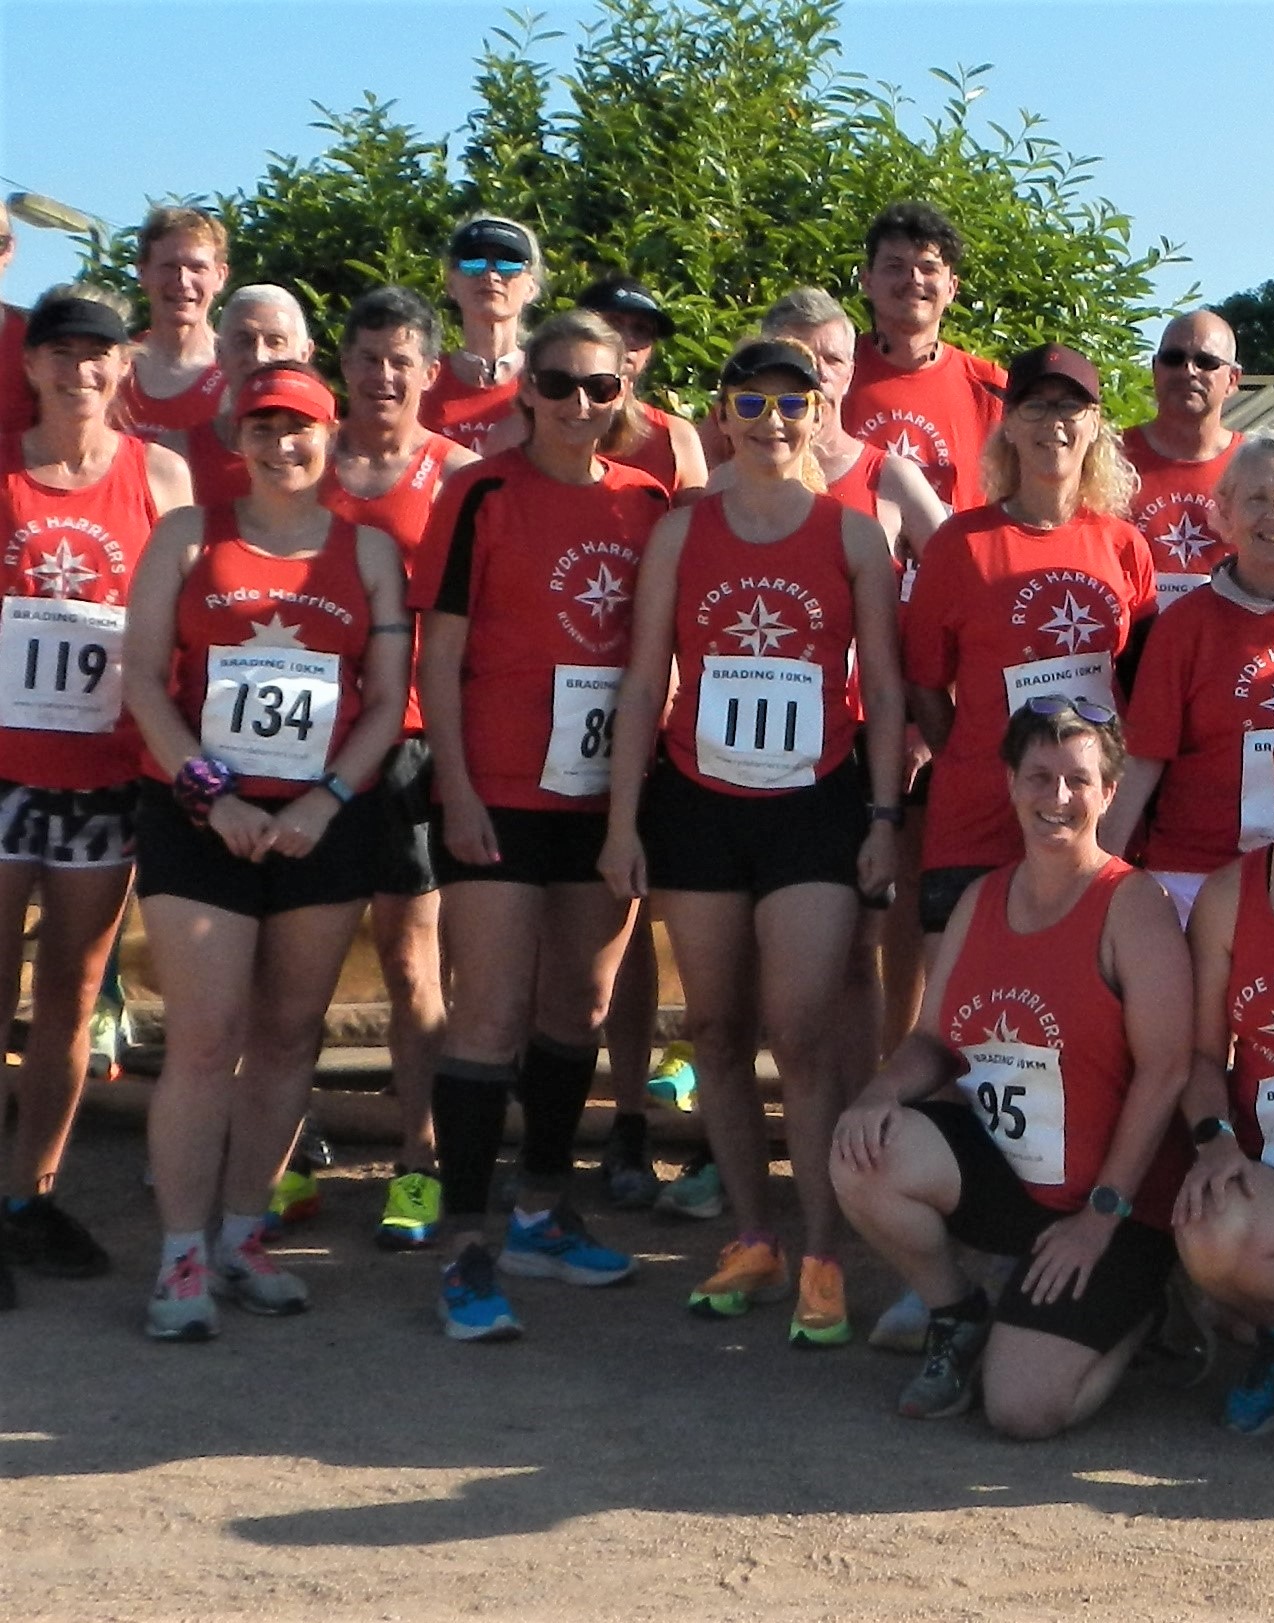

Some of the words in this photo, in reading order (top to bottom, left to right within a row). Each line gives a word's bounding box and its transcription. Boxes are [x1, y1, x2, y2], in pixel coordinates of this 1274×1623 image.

[856, 411, 887, 438] YDE
[891, 409, 951, 468] HARRIERS
[1136, 496, 1167, 533] RYDE
[1170, 492, 1216, 511] HARR
[4, 519, 42, 566] RYDE
[45, 516, 126, 574] HARRIERS
[549, 548, 580, 592] RYDE
[581, 541, 641, 566] HARRI
[205, 586, 261, 609] Ryde
[268, 587, 354, 625] Harriers
[697, 581, 733, 625] RYDE
[740, 576, 824, 630] HARRIERS
[1011, 578, 1043, 625] RYDE
[1045, 571, 1124, 626] HARRIERS
[24, 638, 107, 694] 119
[220, 658, 285, 670] BRADING
[290, 662, 325, 675] 10KM
[566, 679, 620, 691] BRADIN
[712, 669, 775, 681] BRADING
[780, 671, 813, 684] 10KM
[1015, 668, 1073, 689] BRADING
[1075, 664, 1102, 677] 10KM
[1234, 655, 1267, 698] RYDE
[230, 683, 314, 741] 134
[725, 698, 797, 752] 111
[950, 995, 983, 1042] RYDE
[991, 987, 1064, 1050] HARRIERS
[1233, 977, 1267, 1022] RYDE
[977, 1081, 1026, 1139] 95
